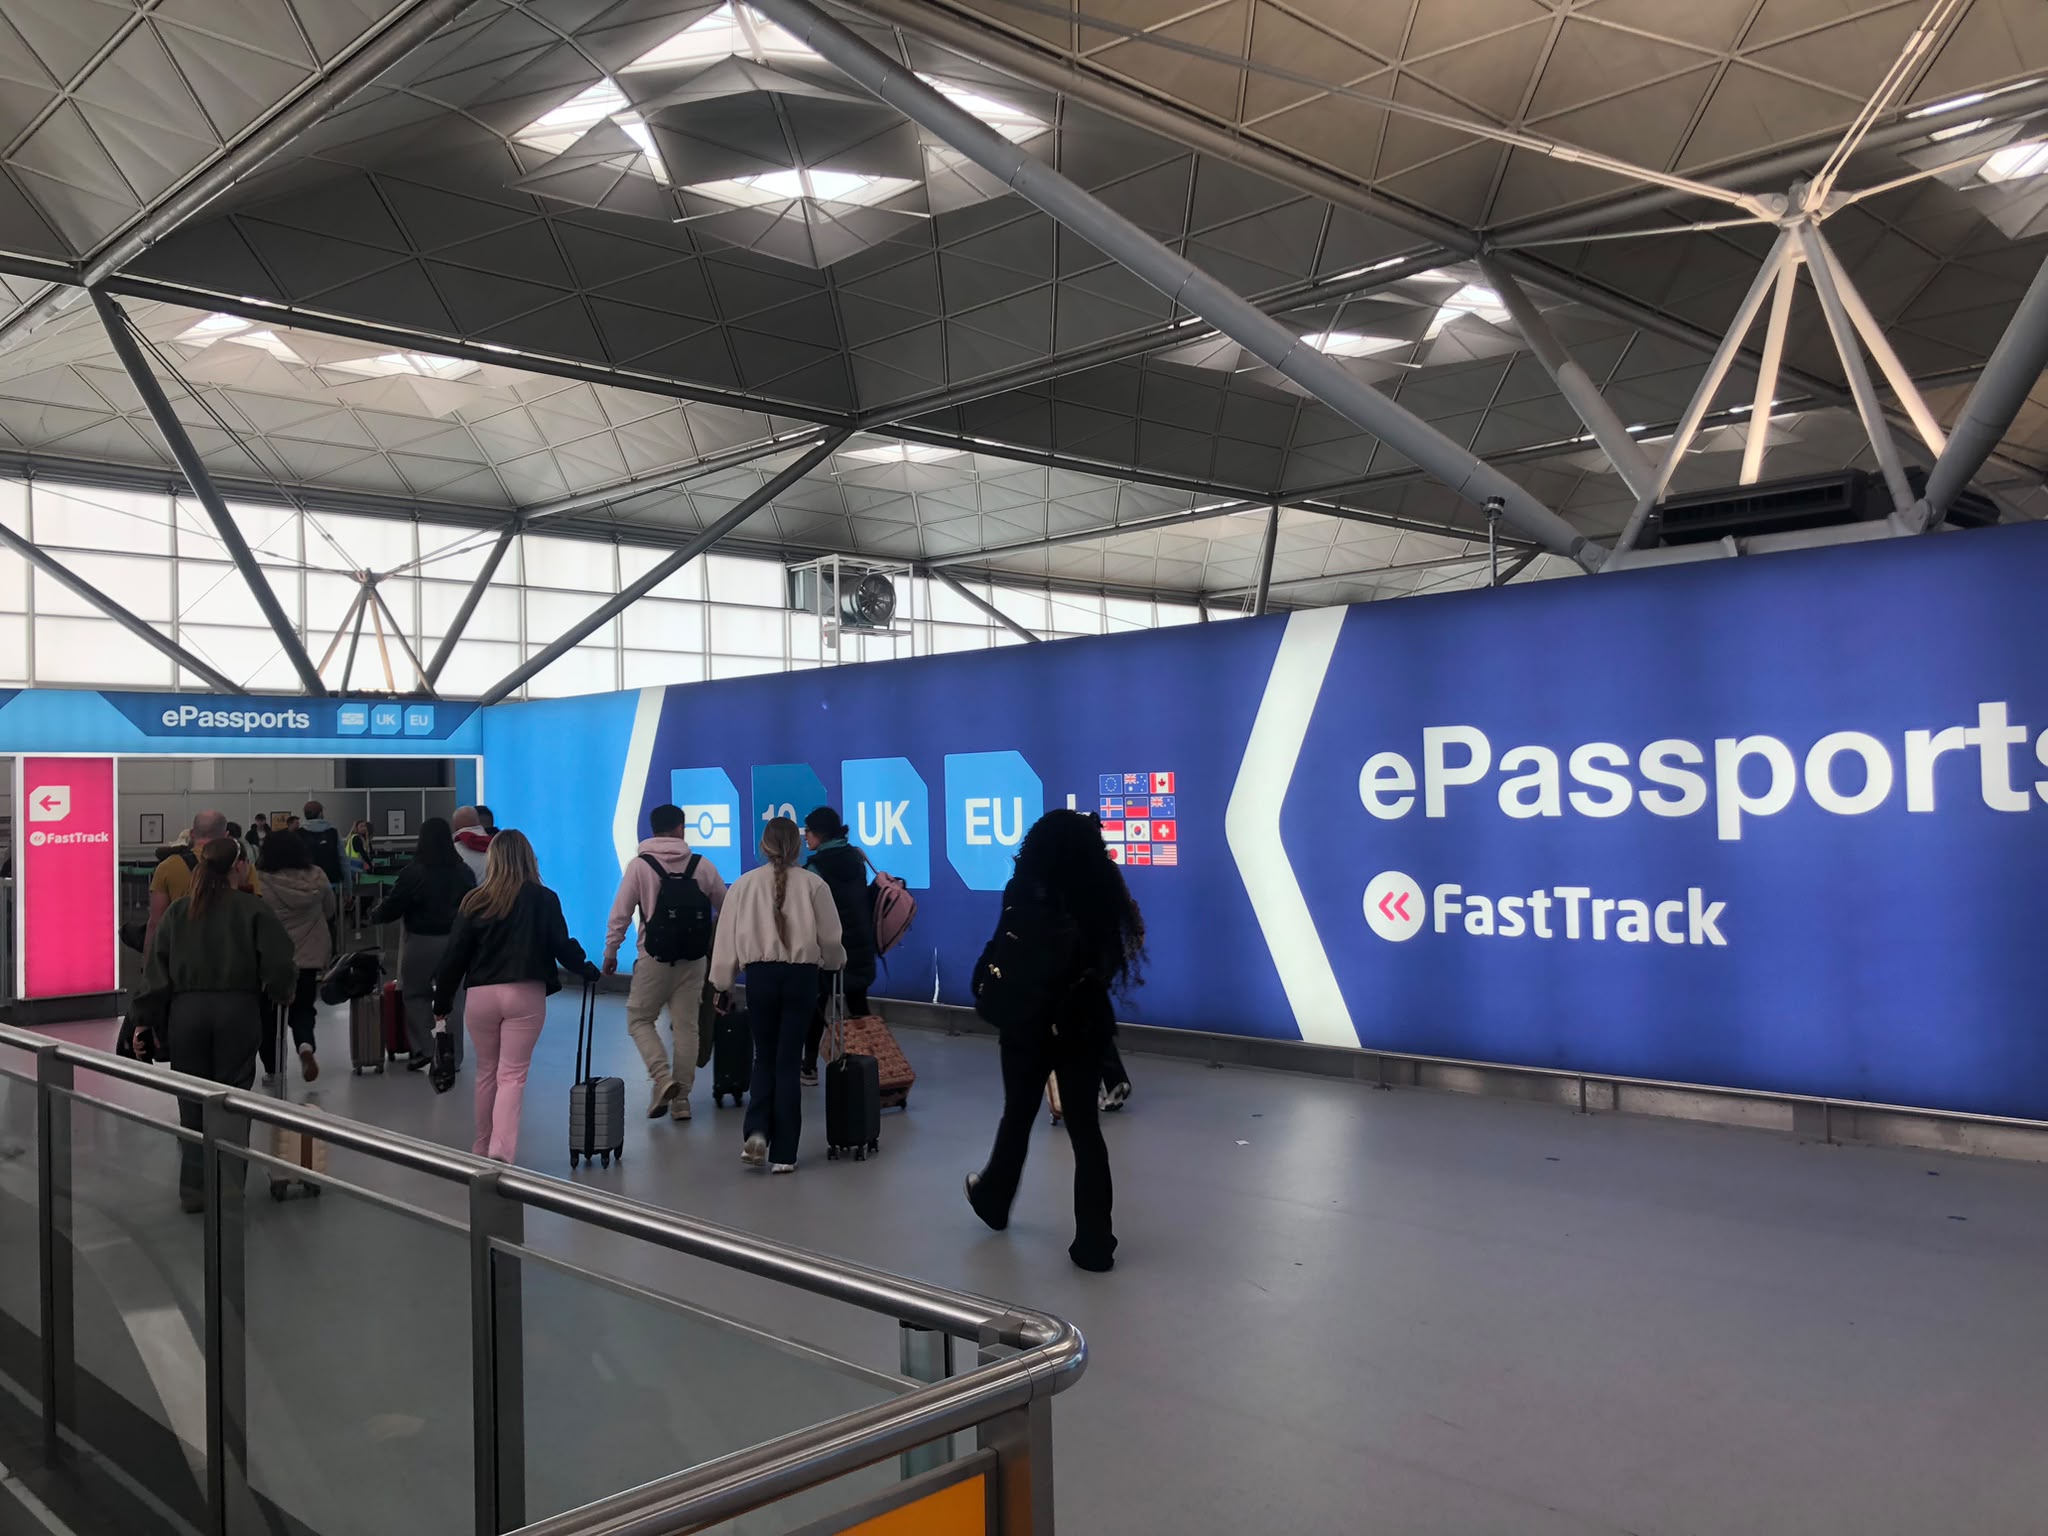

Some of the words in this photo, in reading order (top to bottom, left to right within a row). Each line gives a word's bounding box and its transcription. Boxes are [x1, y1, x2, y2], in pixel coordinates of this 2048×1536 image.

[162, 705, 310, 733] ePassports
[376, 714, 396, 726] UK
[410, 714, 429, 727] EU
[1358, 701, 2048, 841] ePassport
[47, 831, 109, 844] FastTrack
[857, 799, 912, 847] UK
[965, 796, 1023, 846] EU
[1433, 883, 1728, 946] FastTrack
